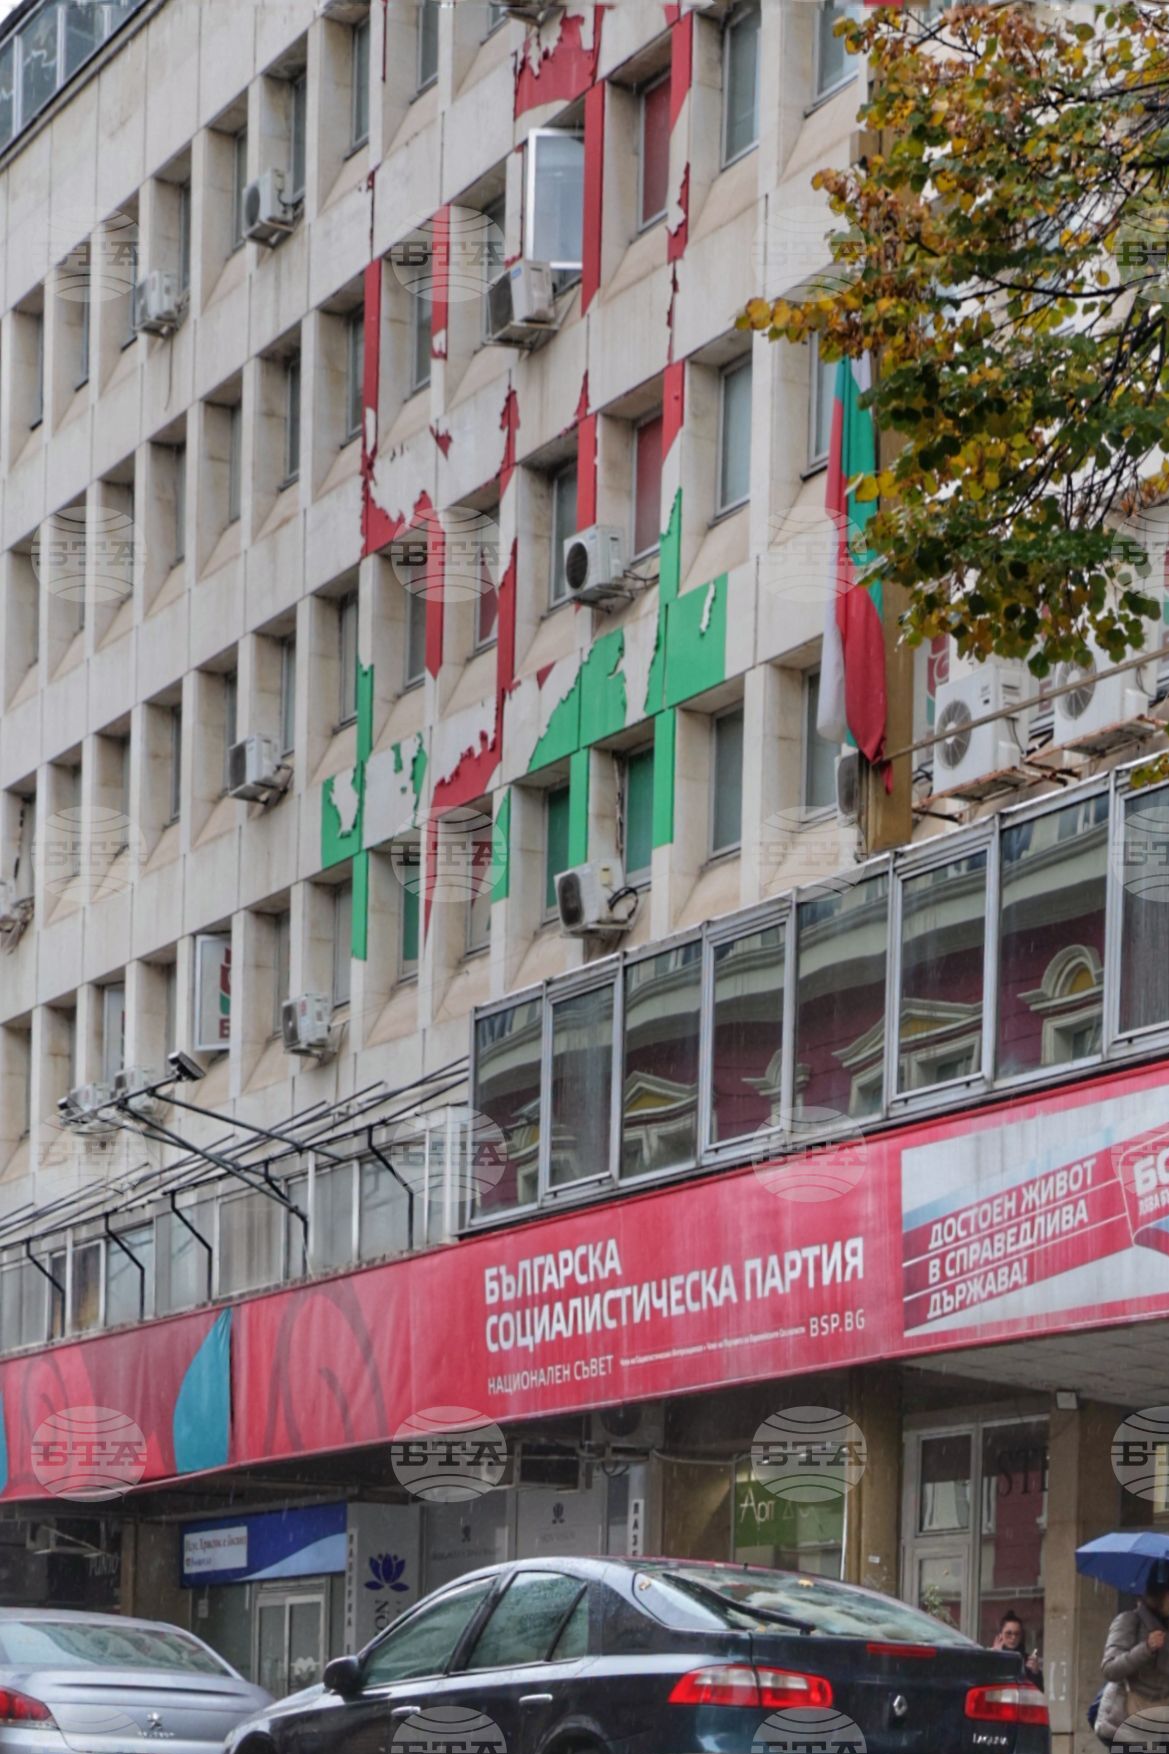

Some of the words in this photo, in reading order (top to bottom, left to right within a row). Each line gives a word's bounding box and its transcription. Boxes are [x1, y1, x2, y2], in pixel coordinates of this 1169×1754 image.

[929, 1194, 1017, 1250] ДОСТОЕН
[1021, 1158, 1097, 1206] ЖИВОТ
[484, 1238, 622, 1304] БЪЛГАРСКА
[929, 1258, 940, 1284] В
[945, 1200, 1088, 1277] СПРАВЕДЛИВА
[485, 1265, 737, 1353] СОЦИАЛИСТИЧЕСКА
[745, 1236, 864, 1301] ПАРТИЯ
[927, 1258, 1028, 1320] ДЪРЖАВА!
[809, 1308, 865, 1338] BSP.BG
[488, 1362, 571, 1395] НАЦИОНАЛЕН
[574, 1355, 613, 1381] СЪВЕТ
